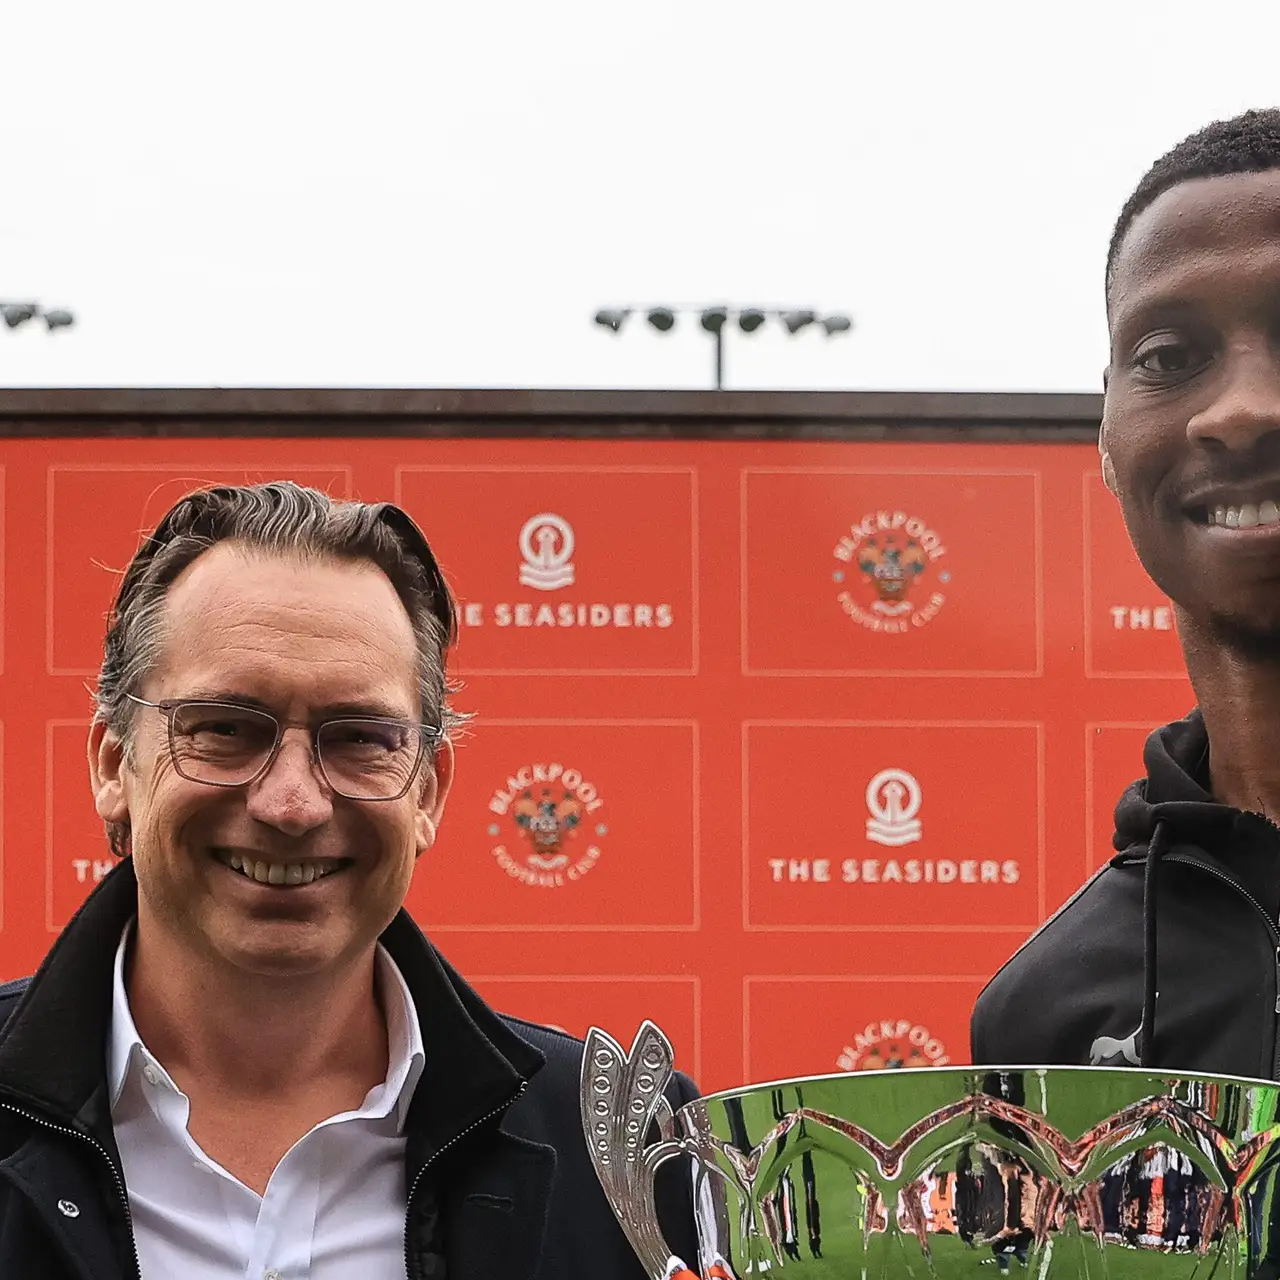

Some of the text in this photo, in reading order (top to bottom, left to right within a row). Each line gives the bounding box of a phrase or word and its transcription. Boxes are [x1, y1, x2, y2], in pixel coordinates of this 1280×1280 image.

[833, 510, 947, 563] BLACKPOOL
[494, 602, 674, 628] SEASIDERS
[1109, 605, 1173, 631] THE
[489, 762, 604, 815] BLACKPOOL
[71, 858, 115, 883] TH
[769, 858, 1020, 884] THE SEASIDERS
